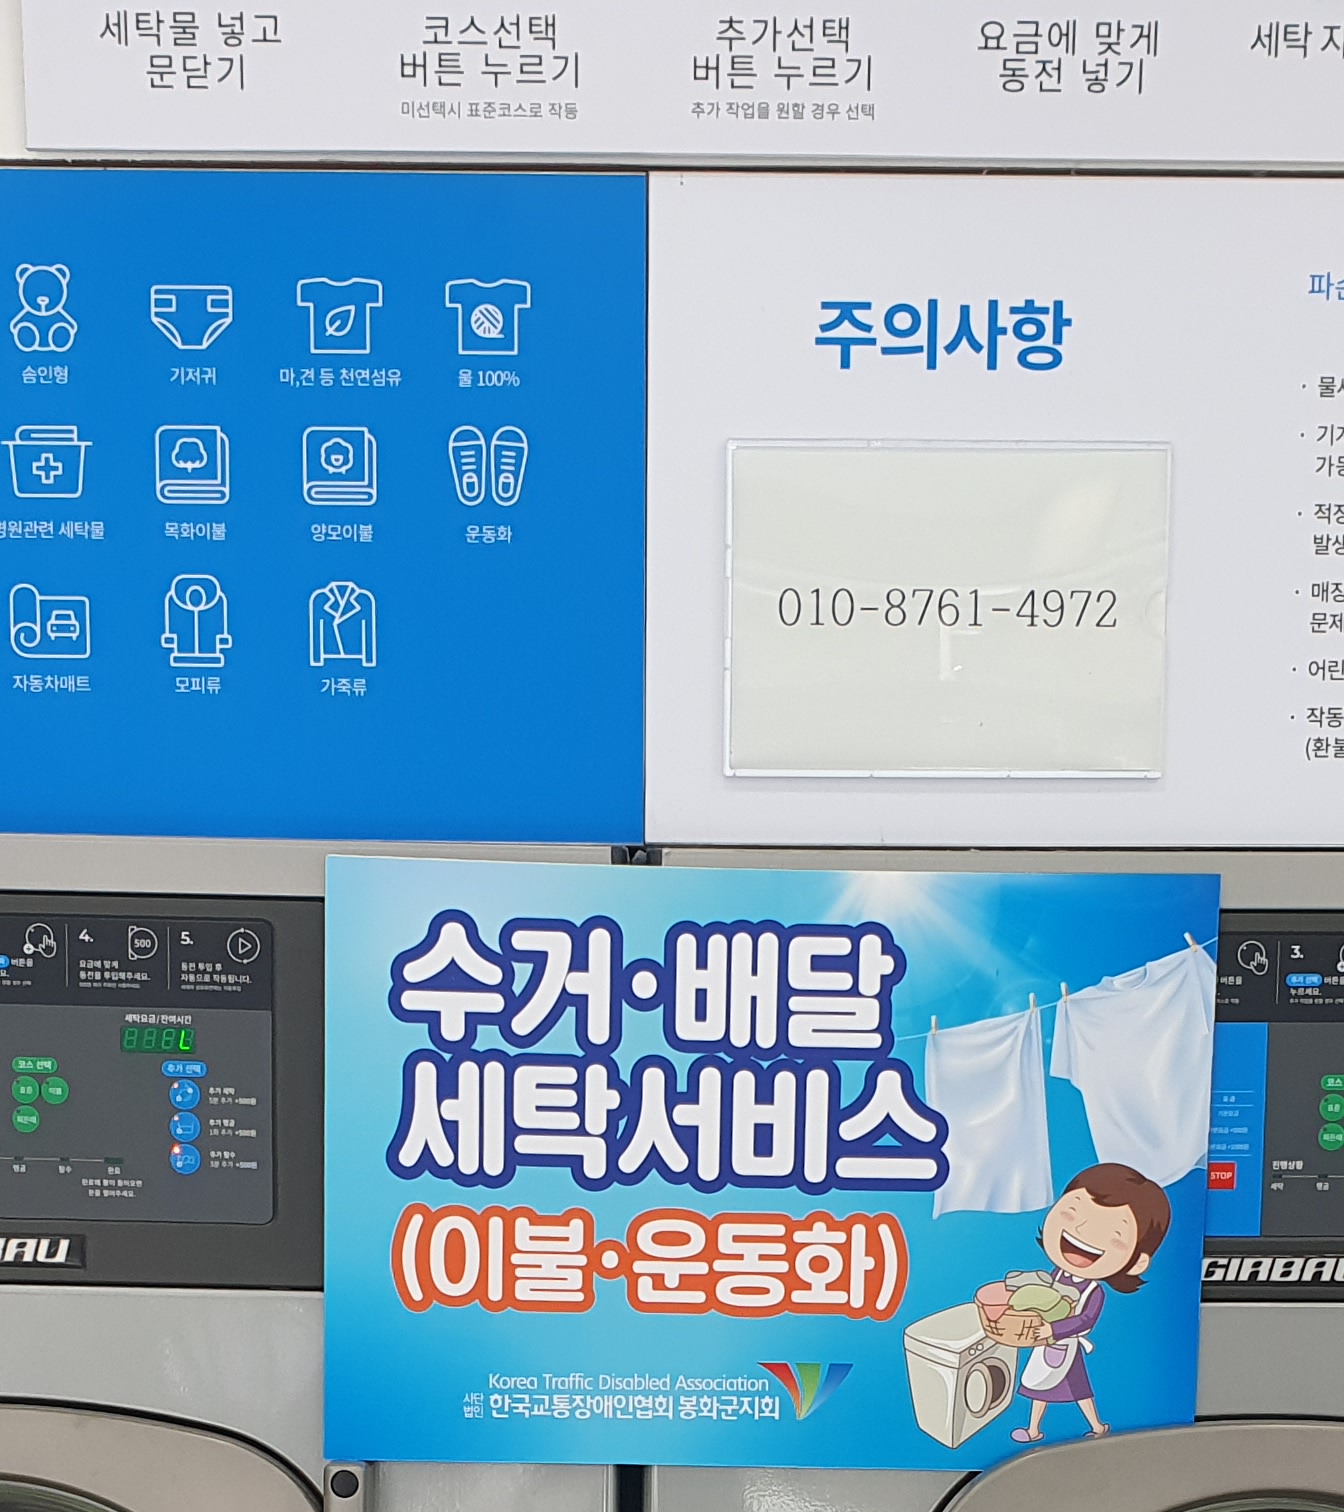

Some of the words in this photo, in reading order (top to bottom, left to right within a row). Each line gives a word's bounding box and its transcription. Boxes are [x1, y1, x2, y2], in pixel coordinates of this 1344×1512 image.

[100, 10, 199, 46] 세탁물
[218, 12, 281, 47] 넣고
[423, 14, 556, 50] 코스선택
[716, 16, 851, 52] 추가선택
[978, 20, 1076, 59] 요금에
[1096, 20, 1159, 58] 맞게
[1251, 22, 1312, 58] 세탁
[147, 54, 244, 90] 문닫기
[401, 51, 464, 87] 버튼
[481, 52, 579, 88] 누르기
[693, 53, 758, 90] 버튼
[772, 53, 872, 91] 누르기
[999, 56, 1062, 93] 동전
[1082, 57, 1144, 94] 넣기
[815, 299, 1072, 370] 주의사항
[22, 366, 68, 384] 솜인형
[171, 367, 216, 385] 기저귀
[280, 368, 314, 387] 마,견
[320, 368, 334, 386] 등
[340, 368, 401, 386] 천연섬유
[459, 369, 472, 387] 울
[478, 371, 520, 386] 100%
[59, 521, 104, 539] 세탁물
[165, 523, 226, 540] 목화이불
[311, 524, 373, 542] 양모이불
[466, 526, 512, 543] 운동화
[779, 588, 1116, 627] 010-8761-4972
[13, 675, 91, 692] 자동차매트
[176, 677, 220, 694] 모피류
[321, 678, 366, 696] 가죽류
[397, 915, 900, 1053] 수거·배달
[392, 1054, 944, 1189] 세탁서비스
[1210, 1171, 1233, 1181] STOP
[397, 1207, 904, 1314] (이불·운동화)
[488, 1373, 537, 1390] Korea
[543, 1373, 593, 1390] Traffic
[599, 1374, 670, 1390] Disabled
[675, 1374, 769, 1391] Association
[463, 1392, 484, 1405] 사단
[490, 1394, 673, 1419] 한국교통장애인협회
[678, 1395, 779, 1419] 봉화군지회
[463, 1405, 484, 1419] 법인
